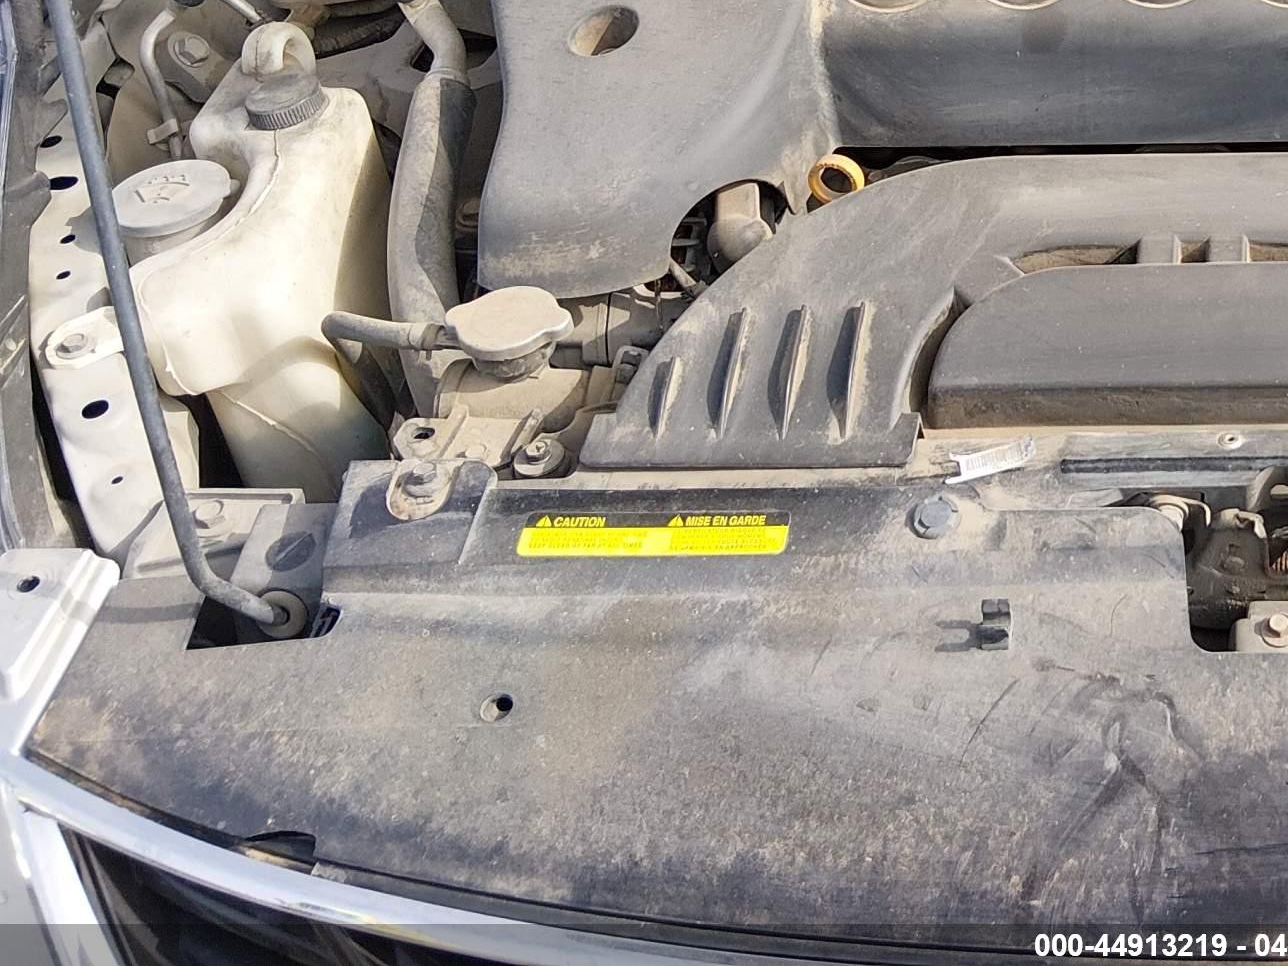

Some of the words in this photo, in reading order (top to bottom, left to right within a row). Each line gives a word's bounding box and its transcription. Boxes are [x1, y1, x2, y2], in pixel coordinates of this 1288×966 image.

[553, 516, 607, 527] CAUTION
[685, 516, 712, 526] MISE
[712, 515, 728, 526] EN
[728, 515, 767, 526] GARDE
